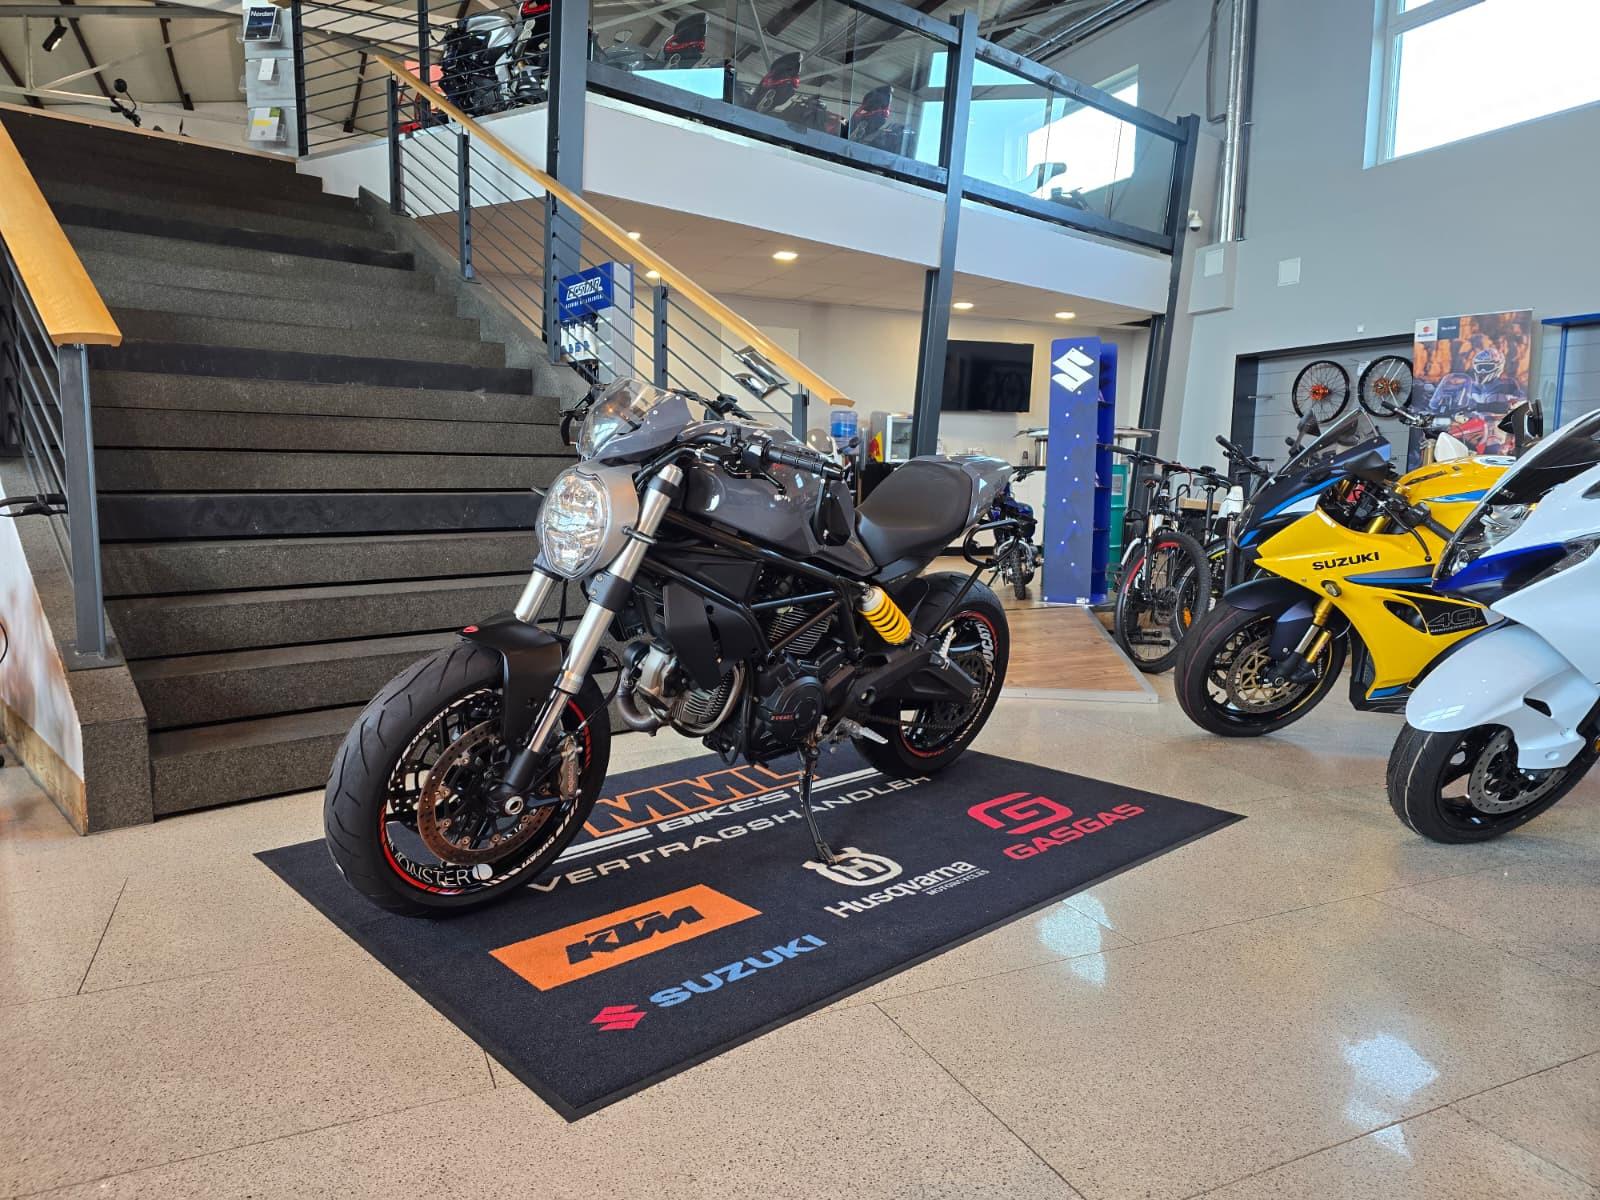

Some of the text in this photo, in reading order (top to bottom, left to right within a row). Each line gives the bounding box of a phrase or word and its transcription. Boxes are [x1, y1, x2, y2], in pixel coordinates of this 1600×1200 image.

[1312, 551, 1380, 570] SUZUKI
[658, 789, 791, 833] BIKES
[1003, 804, 1144, 860] GASGAS
[824, 860, 977, 918] Husqvarna
[565, 905, 705, 965] KTM
[650, 934, 827, 1007] SUZUKI
